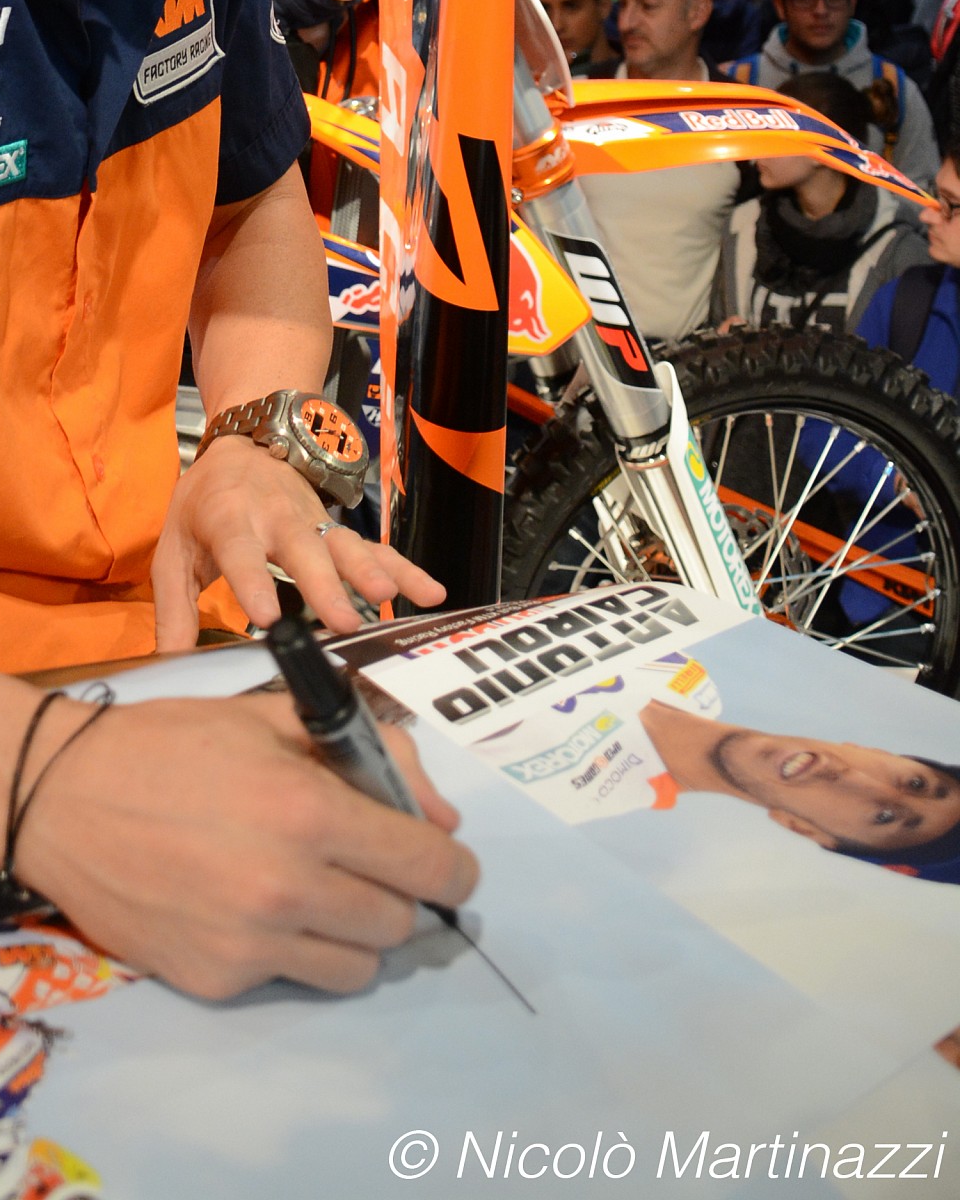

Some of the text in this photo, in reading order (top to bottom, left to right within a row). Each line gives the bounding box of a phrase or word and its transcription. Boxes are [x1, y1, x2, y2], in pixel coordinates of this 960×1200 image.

[143, 48, 187, 84] FACTORY
[432, 598, 700, 725] ANTONIO
[452, 585, 669, 674] CAIROLI
